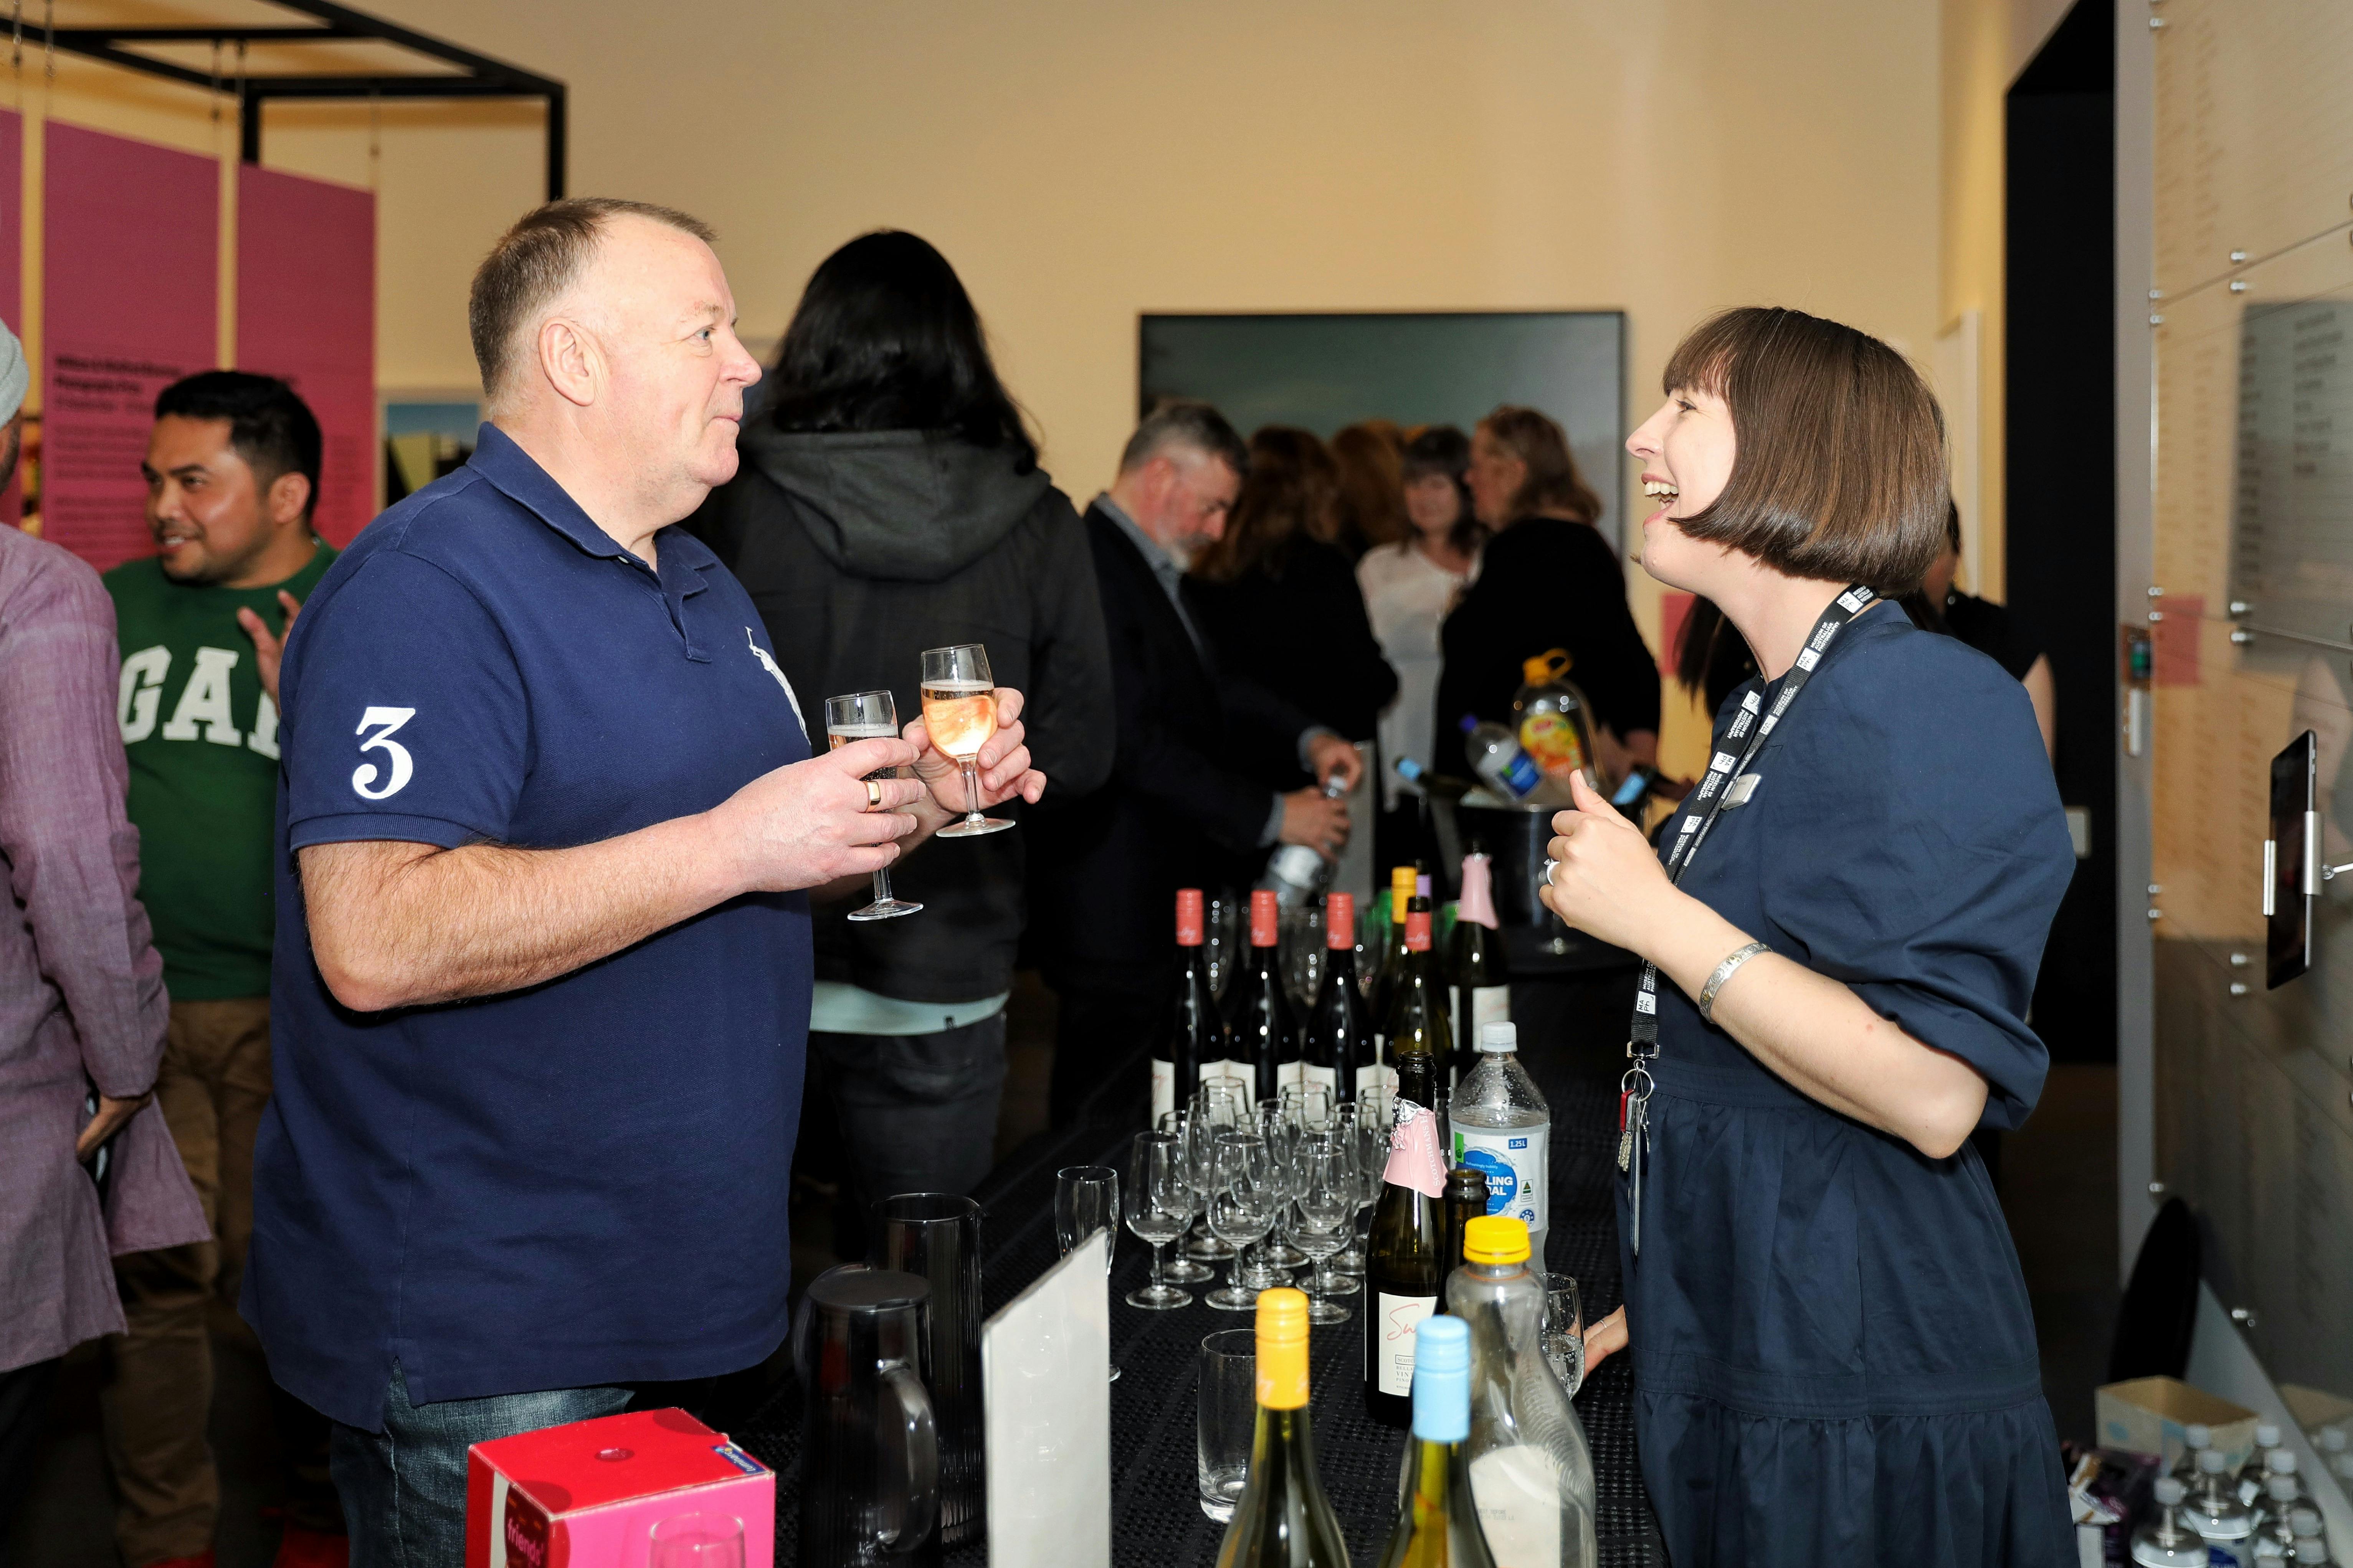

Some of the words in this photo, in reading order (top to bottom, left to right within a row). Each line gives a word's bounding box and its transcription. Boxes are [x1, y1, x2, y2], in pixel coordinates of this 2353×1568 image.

[1810, 628, 1823, 648] MUSEUM
[1814, 622, 1833, 650] AUSTRALIAN
[1818, 621, 1840, 652] PHOTOGRAPHY
[1799, 656, 1807, 666] MA
[1803, 658, 1811, 668] Ph
[1773, 695, 1786, 714] MUSEUM
[1727, 709, 1745, 739] PHOTOGRAPHY
[1733, 711, 1748, 738] AUSTRALIAN
[1743, 714, 1753, 730] MUSEUM
[352, 706, 416, 800] 3
[1718, 755, 1727, 764] Ph
[1725, 757, 1733, 766] MA
[1697, 771, 1714, 801] PHOTOGRAPHY
[1702, 772, 1718, 798] AUSTRALIAN
[1712, 774, 1722, 791] MUSEUM
[1638, 1000, 1644, 1010] MA
[1644, 1001, 1650, 1012] Ph
[1422, 1125, 1440, 1187] SCOTCHMANS
[725, 1451, 756, 1471] Luminarc
